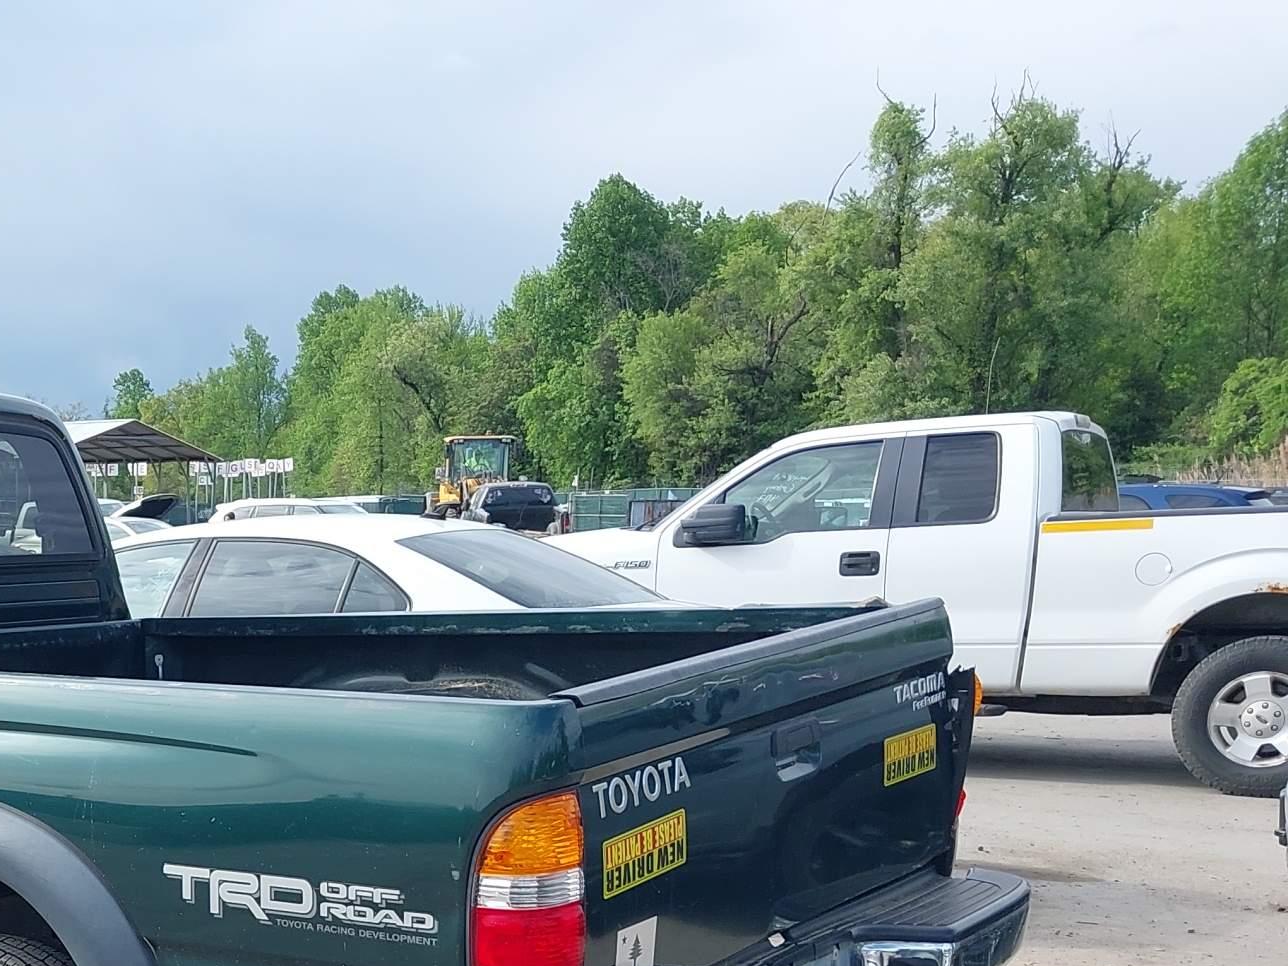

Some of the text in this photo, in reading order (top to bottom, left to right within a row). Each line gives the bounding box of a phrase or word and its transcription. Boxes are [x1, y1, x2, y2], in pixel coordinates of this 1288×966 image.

[893, 672, 946, 704] TACOMA
[886, 747, 935, 781] NEW DRIVER
[592, 757, 692, 819] TOYOTA
[606, 815, 683, 868] PLEASE BE PATIENT
[606, 838, 684, 893] NEW DRIVER
[163, 863, 404, 925] TRD OFF
[276, 918, 439, 947] TOYOTA RACING DEVELOPMENT
[320, 902, 439, 933] ROAD
